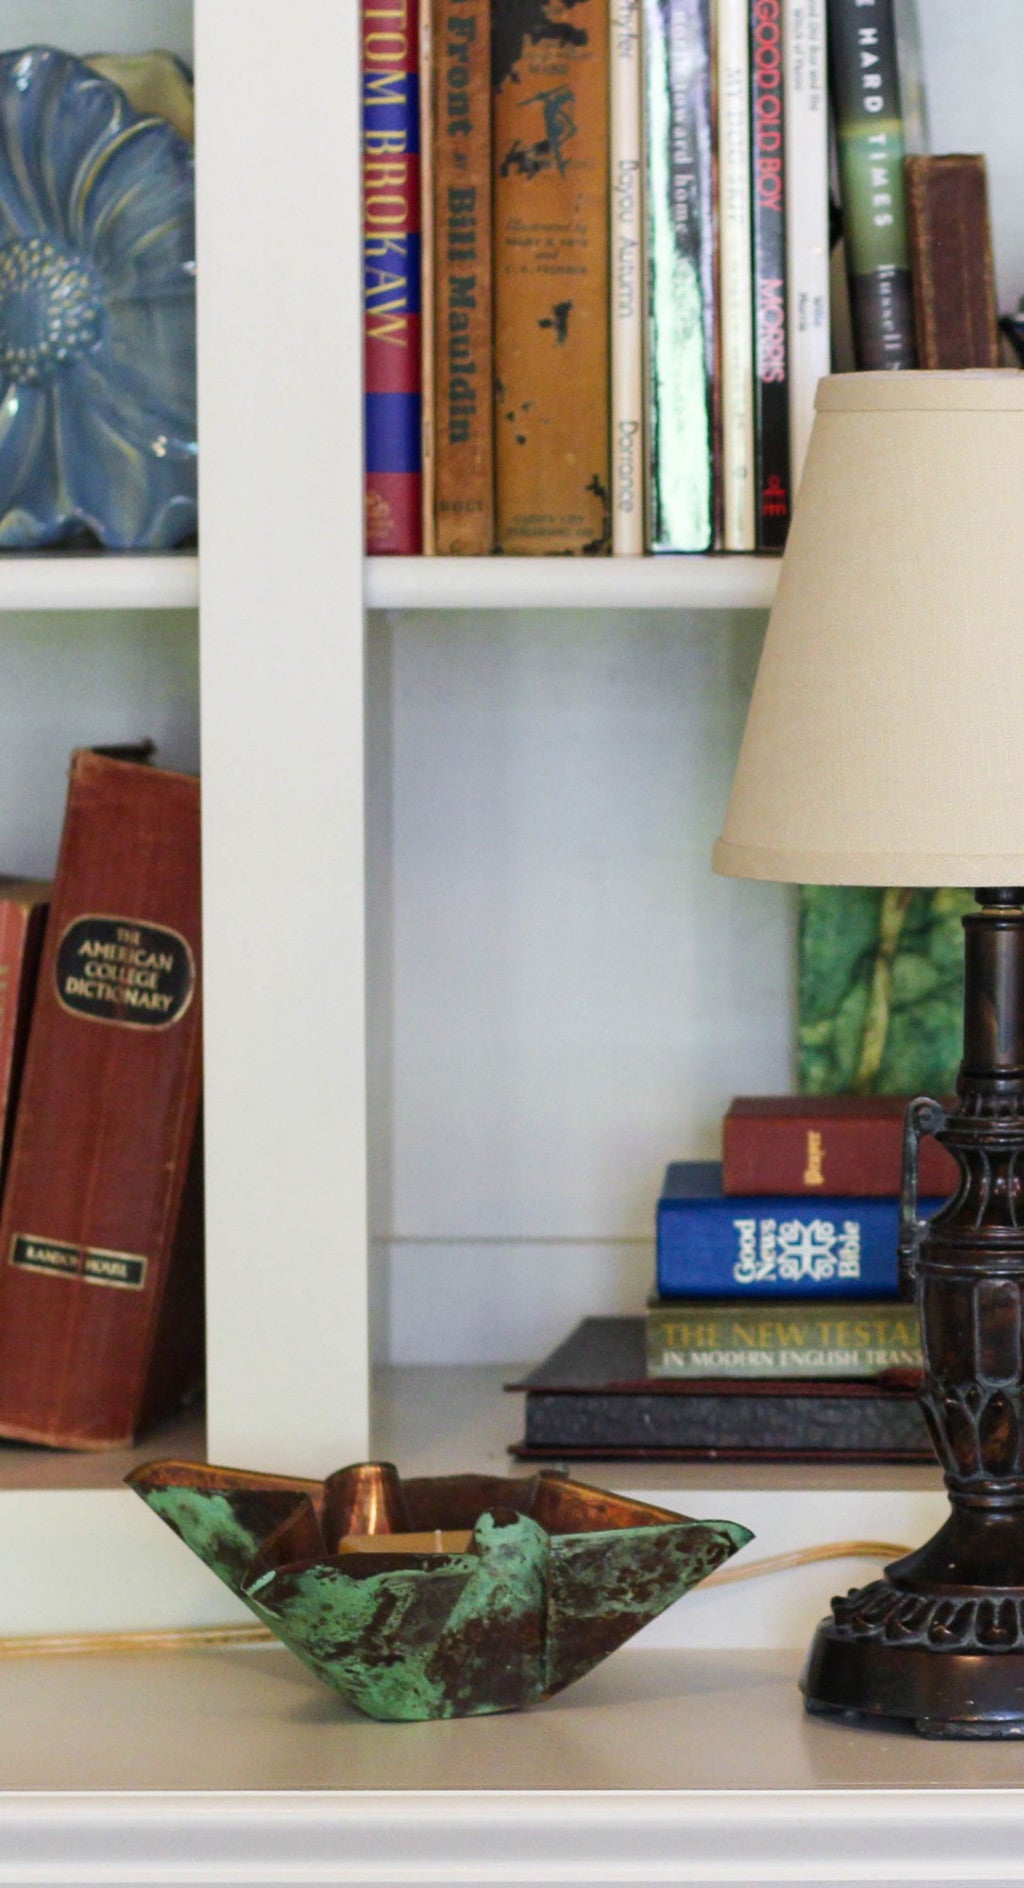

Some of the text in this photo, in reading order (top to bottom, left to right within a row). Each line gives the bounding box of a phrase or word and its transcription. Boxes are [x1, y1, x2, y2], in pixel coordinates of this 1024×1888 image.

[446, 16, 478, 137] Front
[857, 26, 885, 114] HARD
[673, 83, 693, 164] toward
[363, 1, 408, 348] TOM BROKAW
[615, 160, 640, 223] Bayou
[674, 174, 696, 233] home
[755, 0, 785, 383] GOOD OLD BOY MORRIS
[868, 133, 895, 228] TIMES
[447, 187, 478, 263] Bill
[618, 236, 639, 319] Autumn
[876, 263, 902, 351] Russell
[446, 276, 478, 445] Mauldin
[617, 420, 639, 513] Dorrance
[77, 939, 174, 972] AMERICAN
[83, 960, 161, 990] COLLEGE
[732, 1218, 757, 1284] Good
[756, 1218, 777, 1282] News
[837, 1220, 861, 1279] Bible
[662, 1321, 719, 1348] THE
[730, 1321, 806, 1348] NEW
[662, 1349, 684, 1367] IN
[690, 1349, 774, 1367] MODERN
[779, 1349, 859, 1367] ENGLISH
